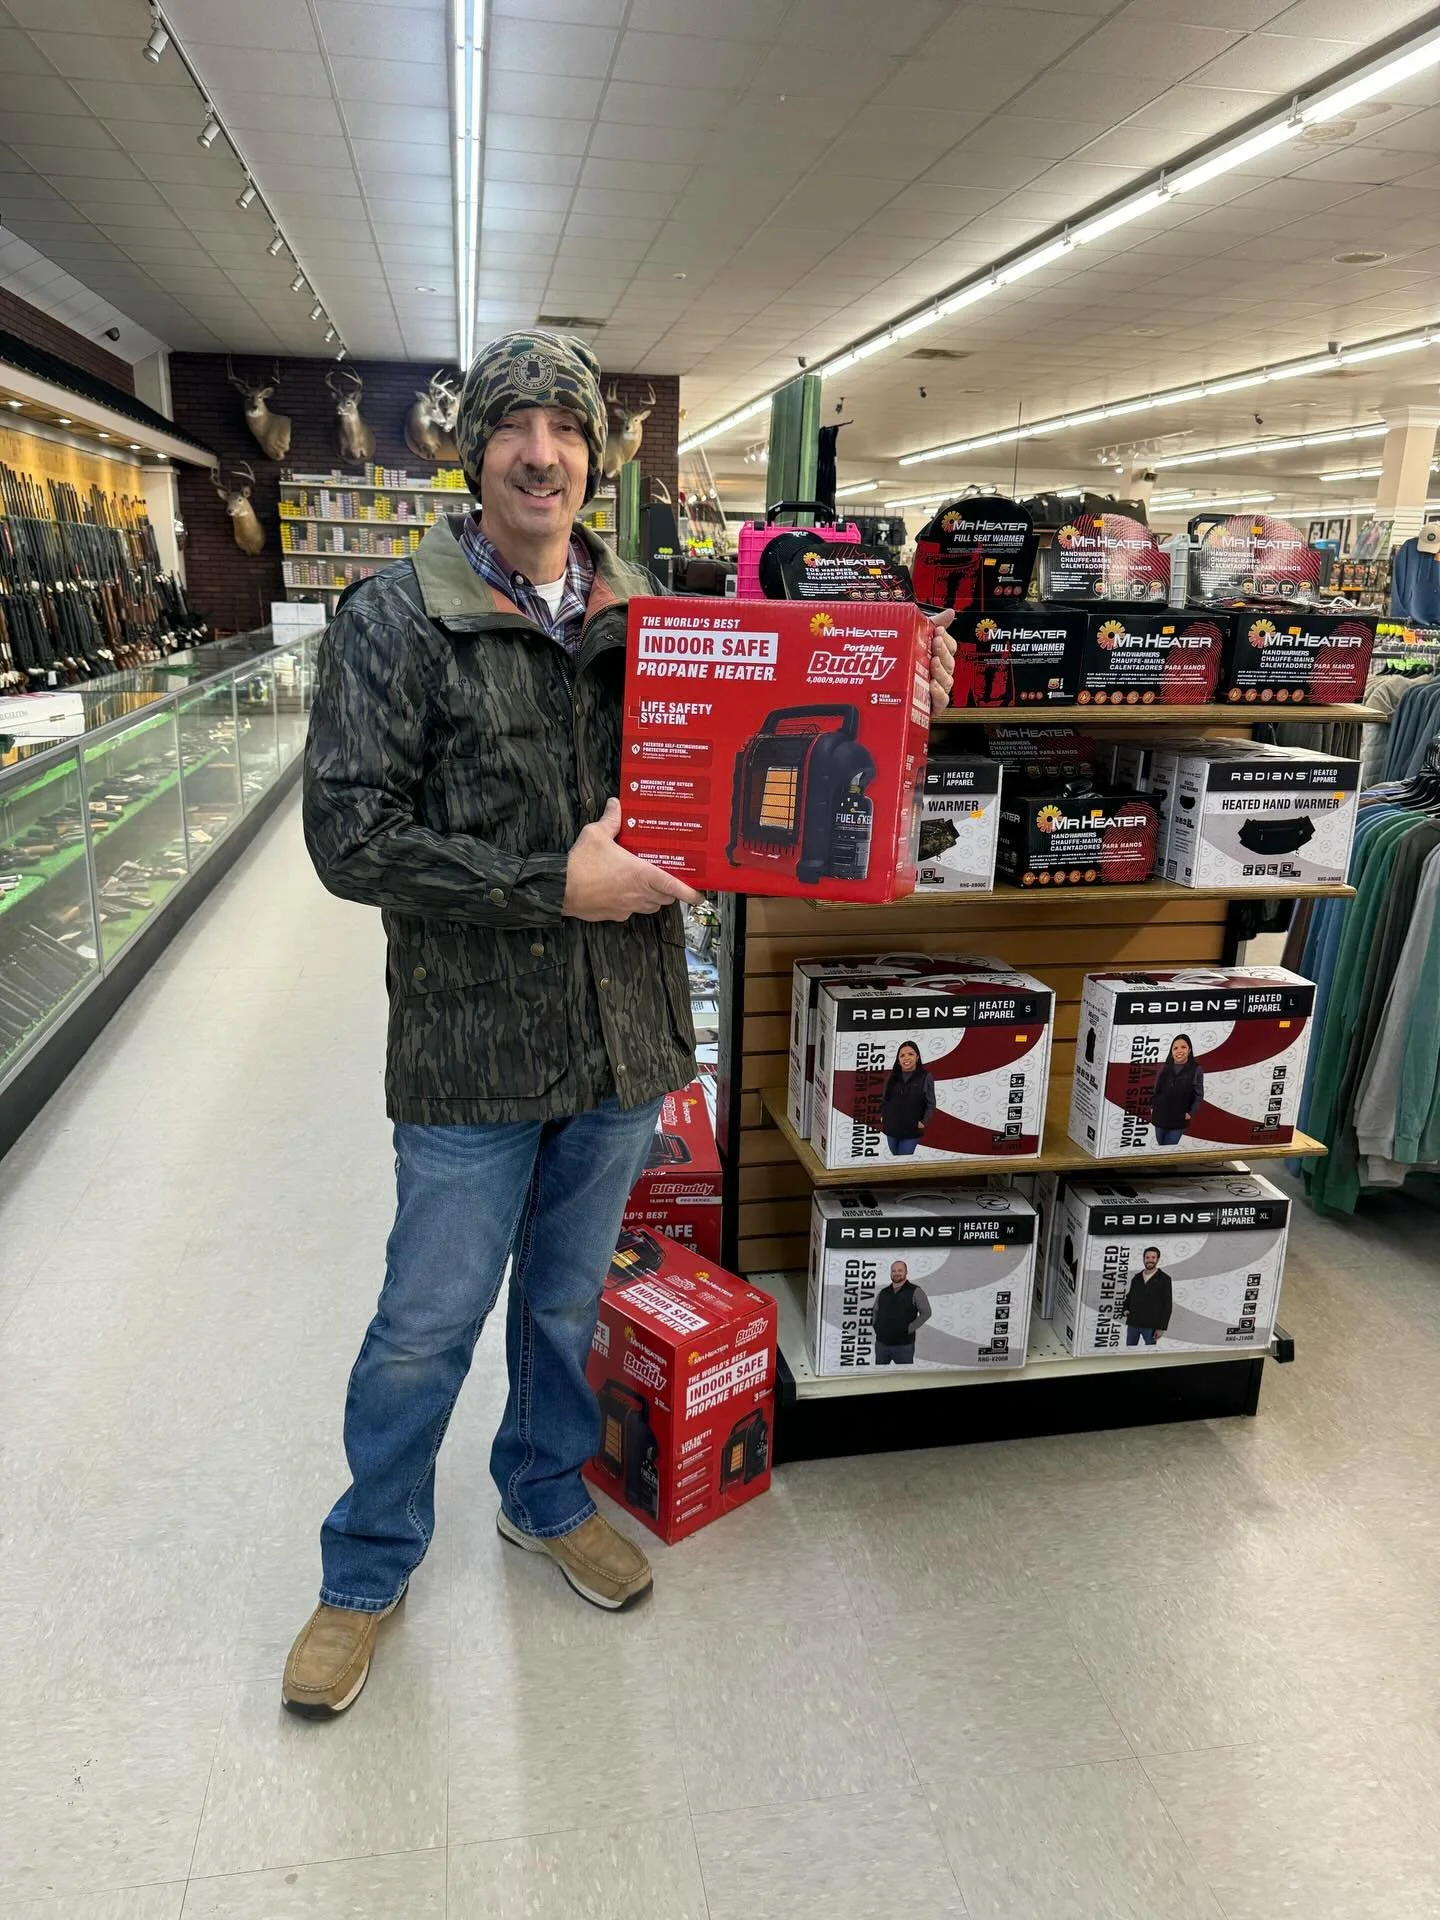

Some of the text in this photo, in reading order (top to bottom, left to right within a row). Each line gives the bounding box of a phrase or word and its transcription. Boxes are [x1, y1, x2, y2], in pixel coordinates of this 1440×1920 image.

[976, 520, 1028, 531] HEATER
[1097, 538, 1152, 549] HEATER
[1247, 537, 1302, 549] HEATER
[836, 558, 885, 566] HEATER
[642, 616, 740, 629] THE WORLD'S BEST
[845, 626, 898, 638] HEATER
[1012, 628, 1067, 639] HEATER
[644, 635, 769, 657] INDOOR SAFE
[990, 643, 1065, 652] FULL SEAT WARMER
[1145, 634, 1212, 648] HEATER
[1295, 633, 1362, 648] HEATER
[843, 644, 884, 652] Portable
[637, 662, 707, 679] PROPANE
[807, 651, 897, 680] Buddy
[850, 677, 864, 685] BTU
[871, 693, 878, 704] 3
[641, 701, 712, 715] LIFE SAFETY
[928, 801, 979, 811] WARMER
[1222, 799, 1339, 810] HEATED HAND WARMER
[1082, 816, 1147, 829] HEATER
[979, 1000, 1015, 1010] HEATED
[1249, 994, 1282, 1002] HEATED
[978, 1005, 1031, 1020] APPAREL S
[1248, 1004, 1281, 1012] APPAREL
[868, 1043, 886, 1085] VEST
[1128, 1036, 1145, 1083] HEATED
[1141, 1036, 1160, 1078] VEST
[856, 1043, 870, 1091] HEATED
[646, 1211, 668, 1219] BEST
[1222, 1208, 1255, 1216] HEATED
[1222, 1212, 1269, 1225] APPAREL XL
[654, 1225, 693, 1238] SAFE
[963, 1226, 1014, 1240] APPAREL M
[964, 1222, 999, 1230] HEATED
[616, 1291, 656, 1315] PROPANE
[1094, 1245, 1119, 1348] MEN'S HEATED
[1109, 1246, 1130, 1347] SOFT SHELL JACKET
[632, 1286, 702, 1327] INDOOR SAFE
[840, 1259, 860, 1366] MEN'S HEATED
[856, 1261, 877, 1366] PUFFER VEST
[736, 1320, 768, 1344] Buddy
[624, 1351, 667, 1390] Buddy
[688, 1351, 747, 1385] THE WORLD'S BEST
[691, 1355, 763, 1402] INDOOR SAFE
[686, 1389, 729, 1420] PROPANE
